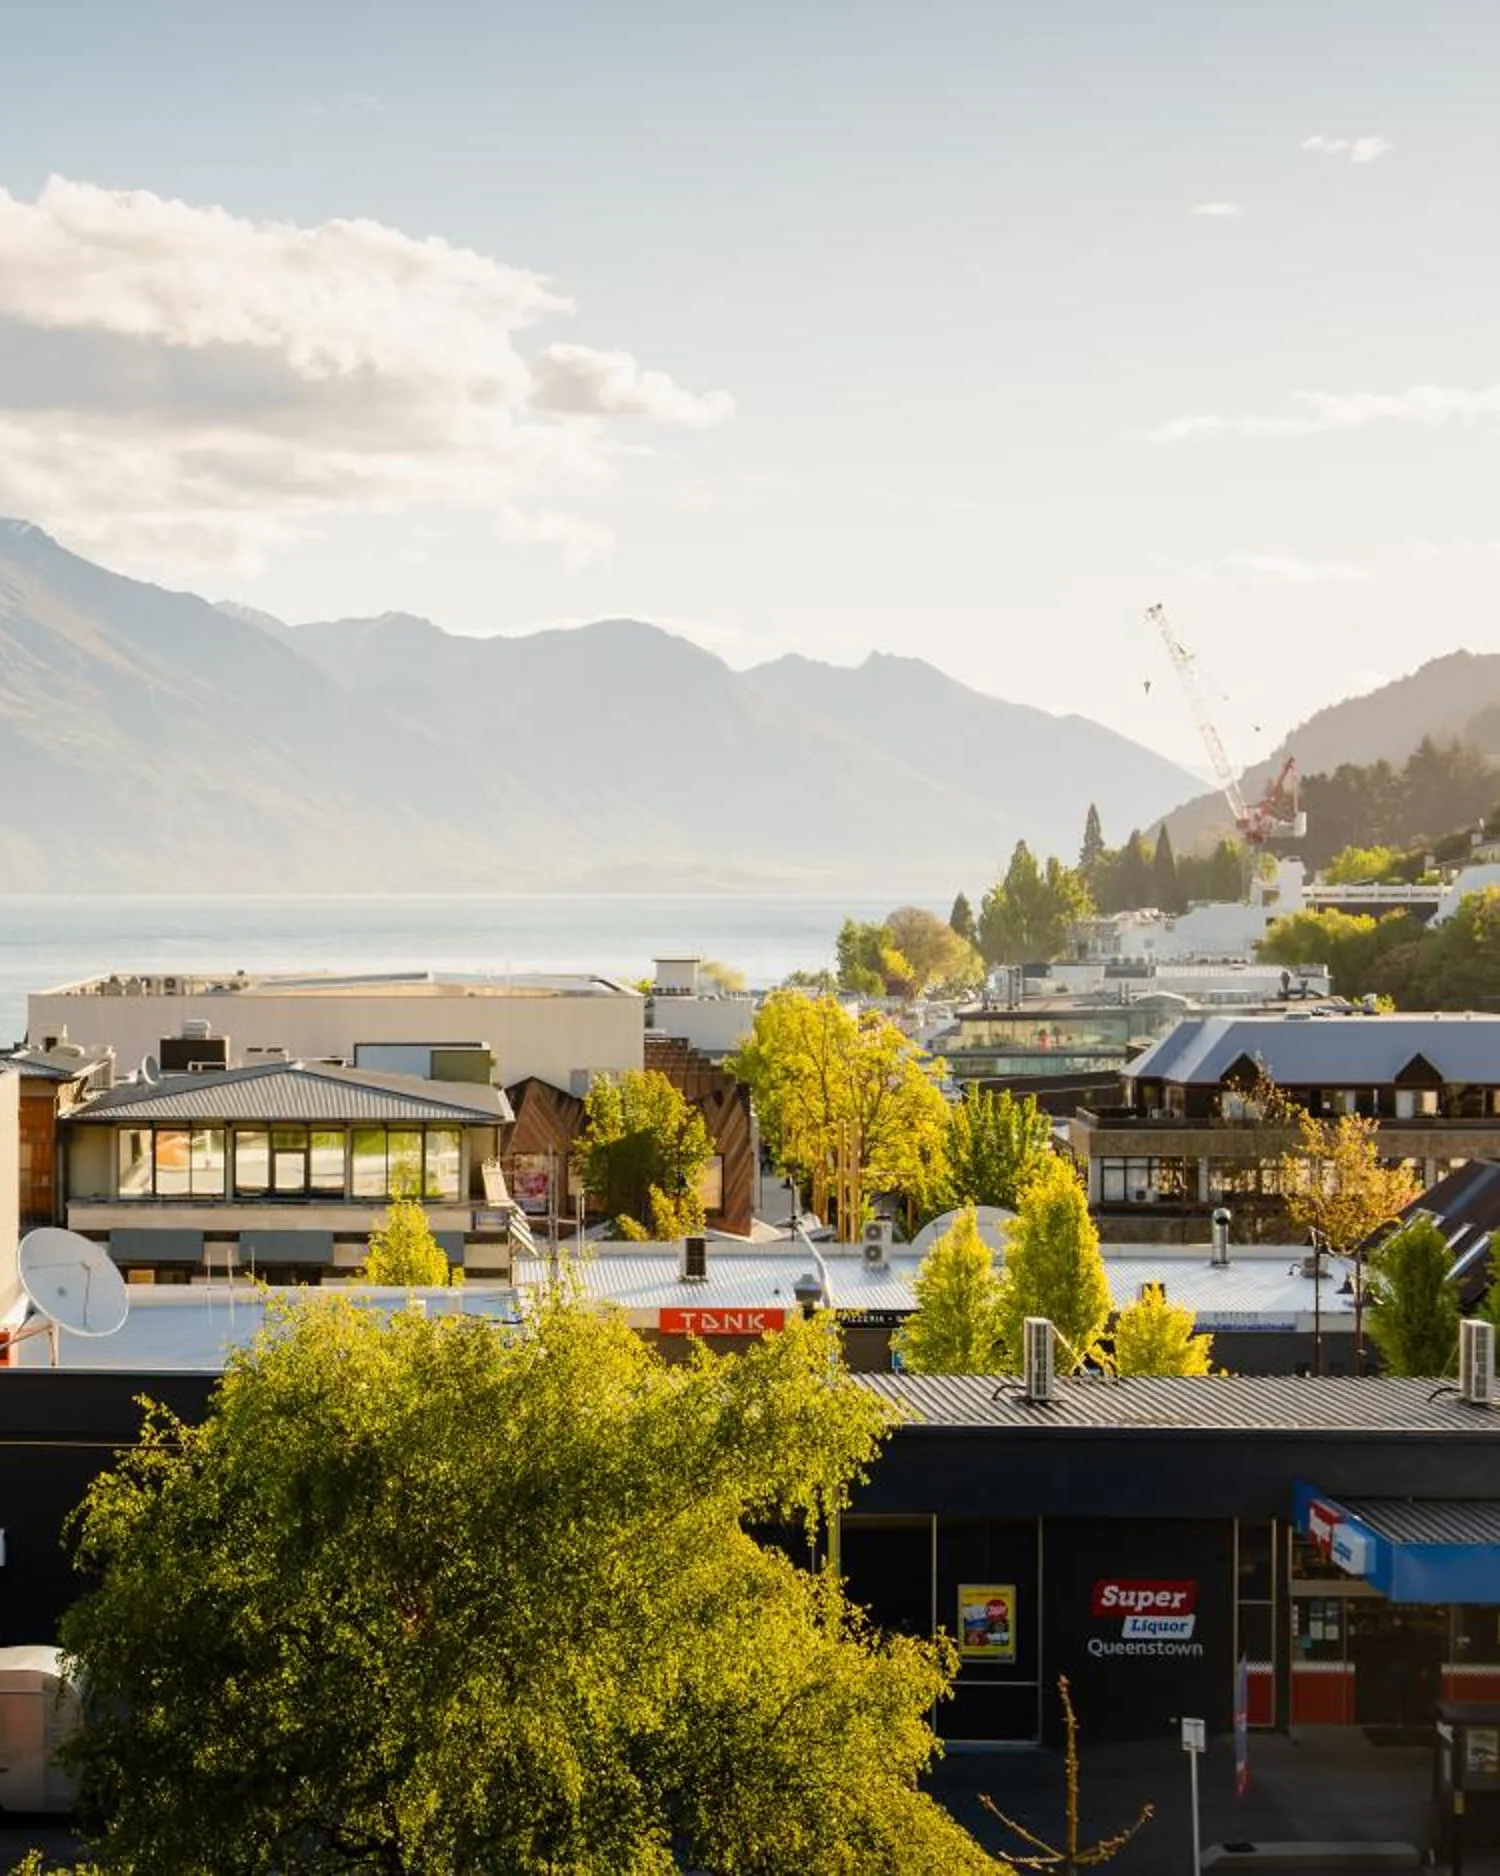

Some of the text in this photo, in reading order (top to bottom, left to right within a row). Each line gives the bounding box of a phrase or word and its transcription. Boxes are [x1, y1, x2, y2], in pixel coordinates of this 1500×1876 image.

[1101, 1585, 1187, 1612] Super
[1131, 1619, 1189, 1634] Liquor
[1087, 1639, 1204, 1657] Queenstown
